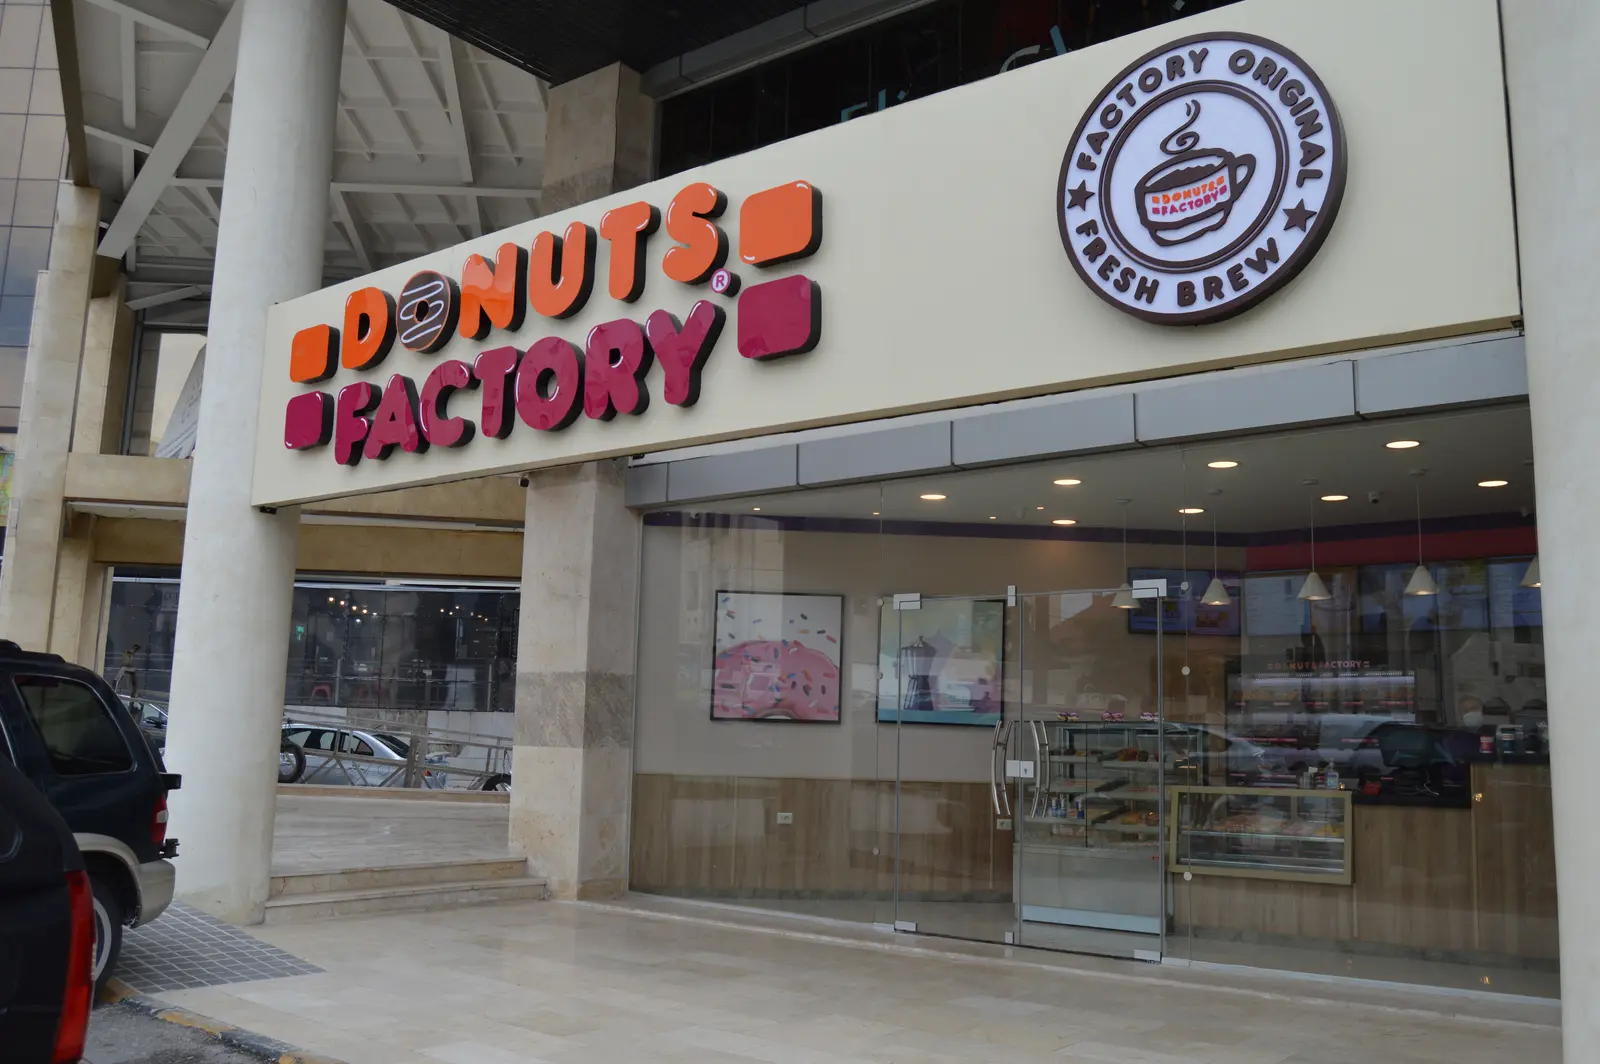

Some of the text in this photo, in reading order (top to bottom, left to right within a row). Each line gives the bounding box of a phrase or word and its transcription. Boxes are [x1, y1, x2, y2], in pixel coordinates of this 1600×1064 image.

[1076, 47, 1325, 187] FACTORY ORIGINAL
[1161, 189, 1219, 217] FACTORY
[1162, 180, 1216, 205] DONUTS
[341, 180, 728, 370] DONUTS
[1075, 219, 1280, 308] FRESH BREW
[334, 291, 726, 465] FACTORY
